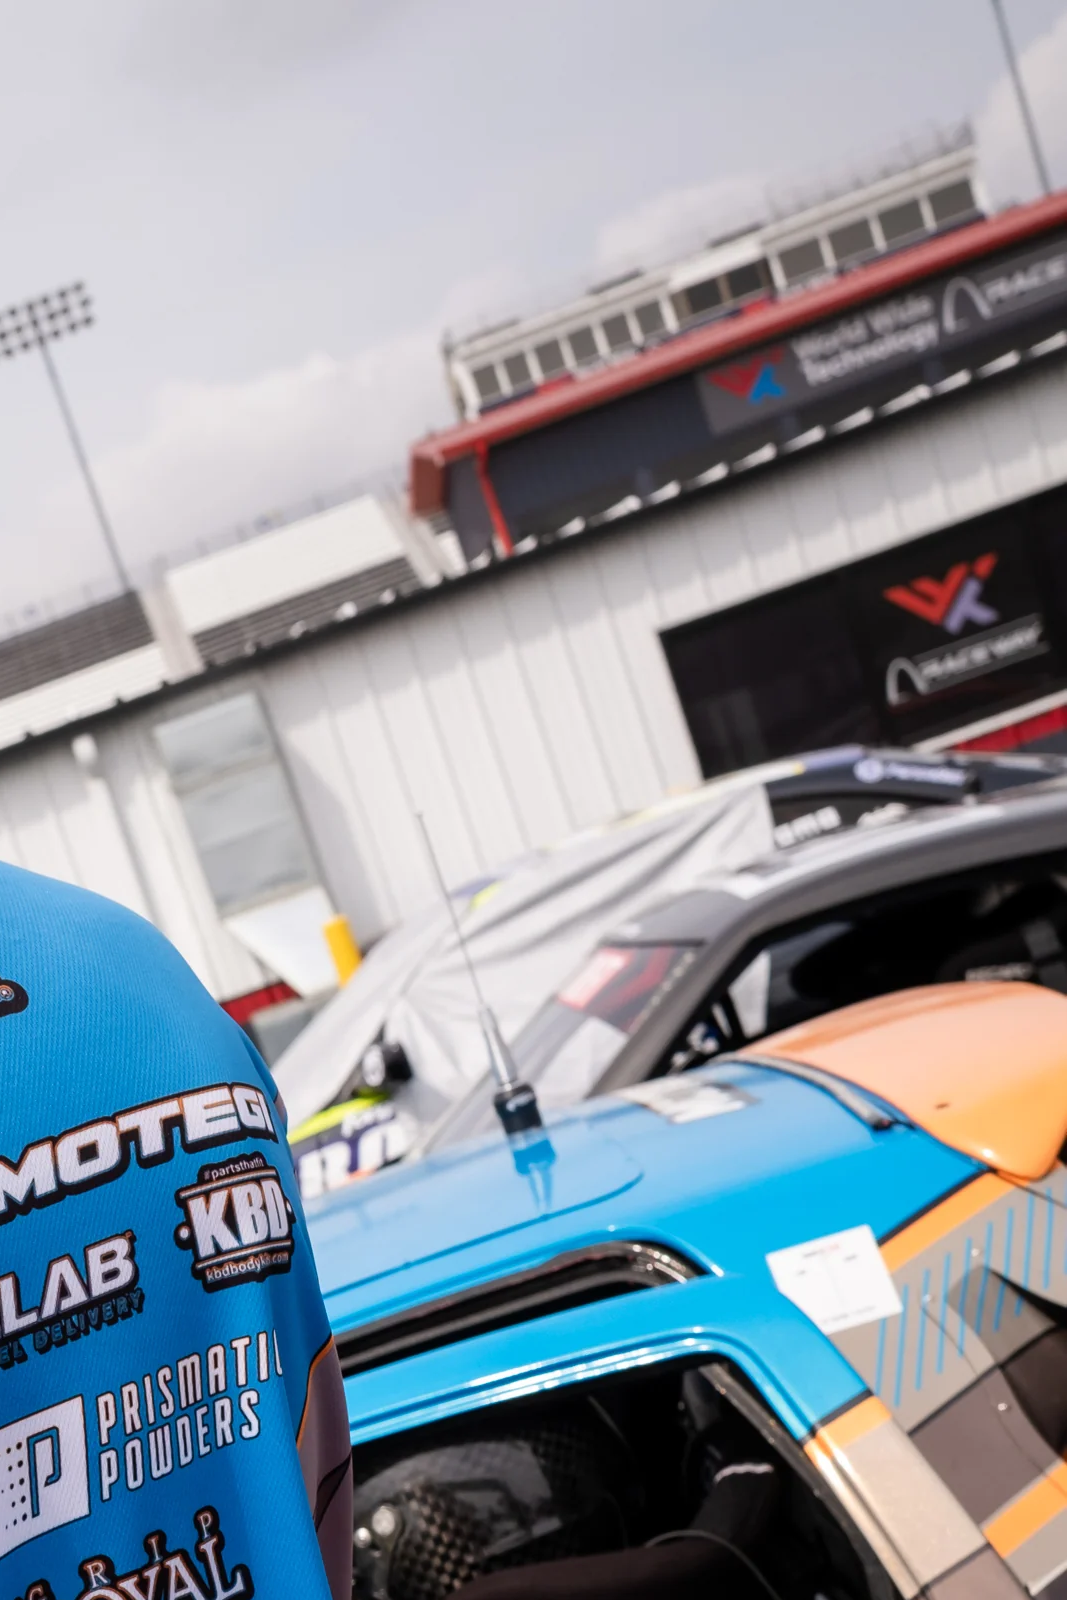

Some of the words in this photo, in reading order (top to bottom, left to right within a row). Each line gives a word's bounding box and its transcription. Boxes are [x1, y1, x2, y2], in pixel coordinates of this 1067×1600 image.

[186, 1177, 290, 1259] KBD
[33, 1288, 145, 1352] DELIVERY
[98, 1389, 260, 1502] POWDERS
